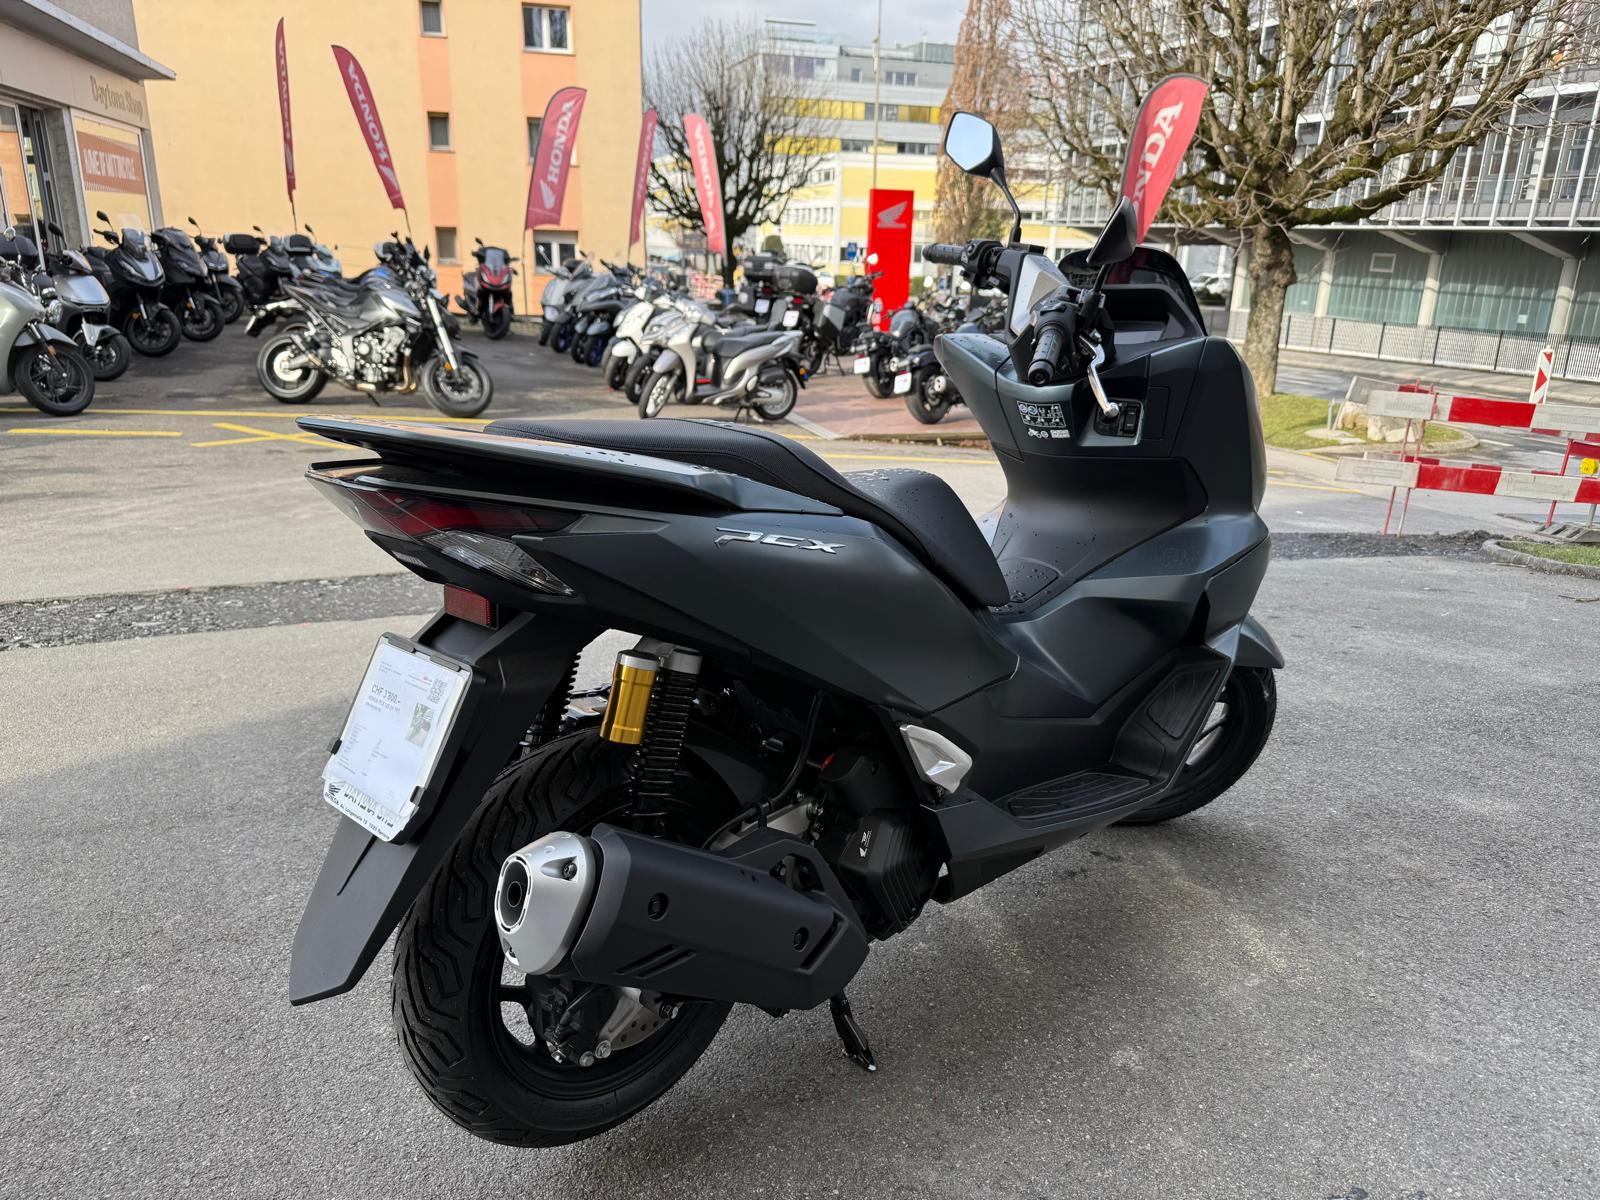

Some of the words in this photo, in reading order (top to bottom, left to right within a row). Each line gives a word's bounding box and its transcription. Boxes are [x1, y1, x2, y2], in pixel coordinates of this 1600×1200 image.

[90, 74, 125, 110] Daytona
[123, 89, 143, 118] Shop
[348, 59, 388, 162] HONDA
[547, 99, 575, 185] HONDA
[1133, 101, 1184, 215] NDA
[714, 527, 846, 554] PCX
